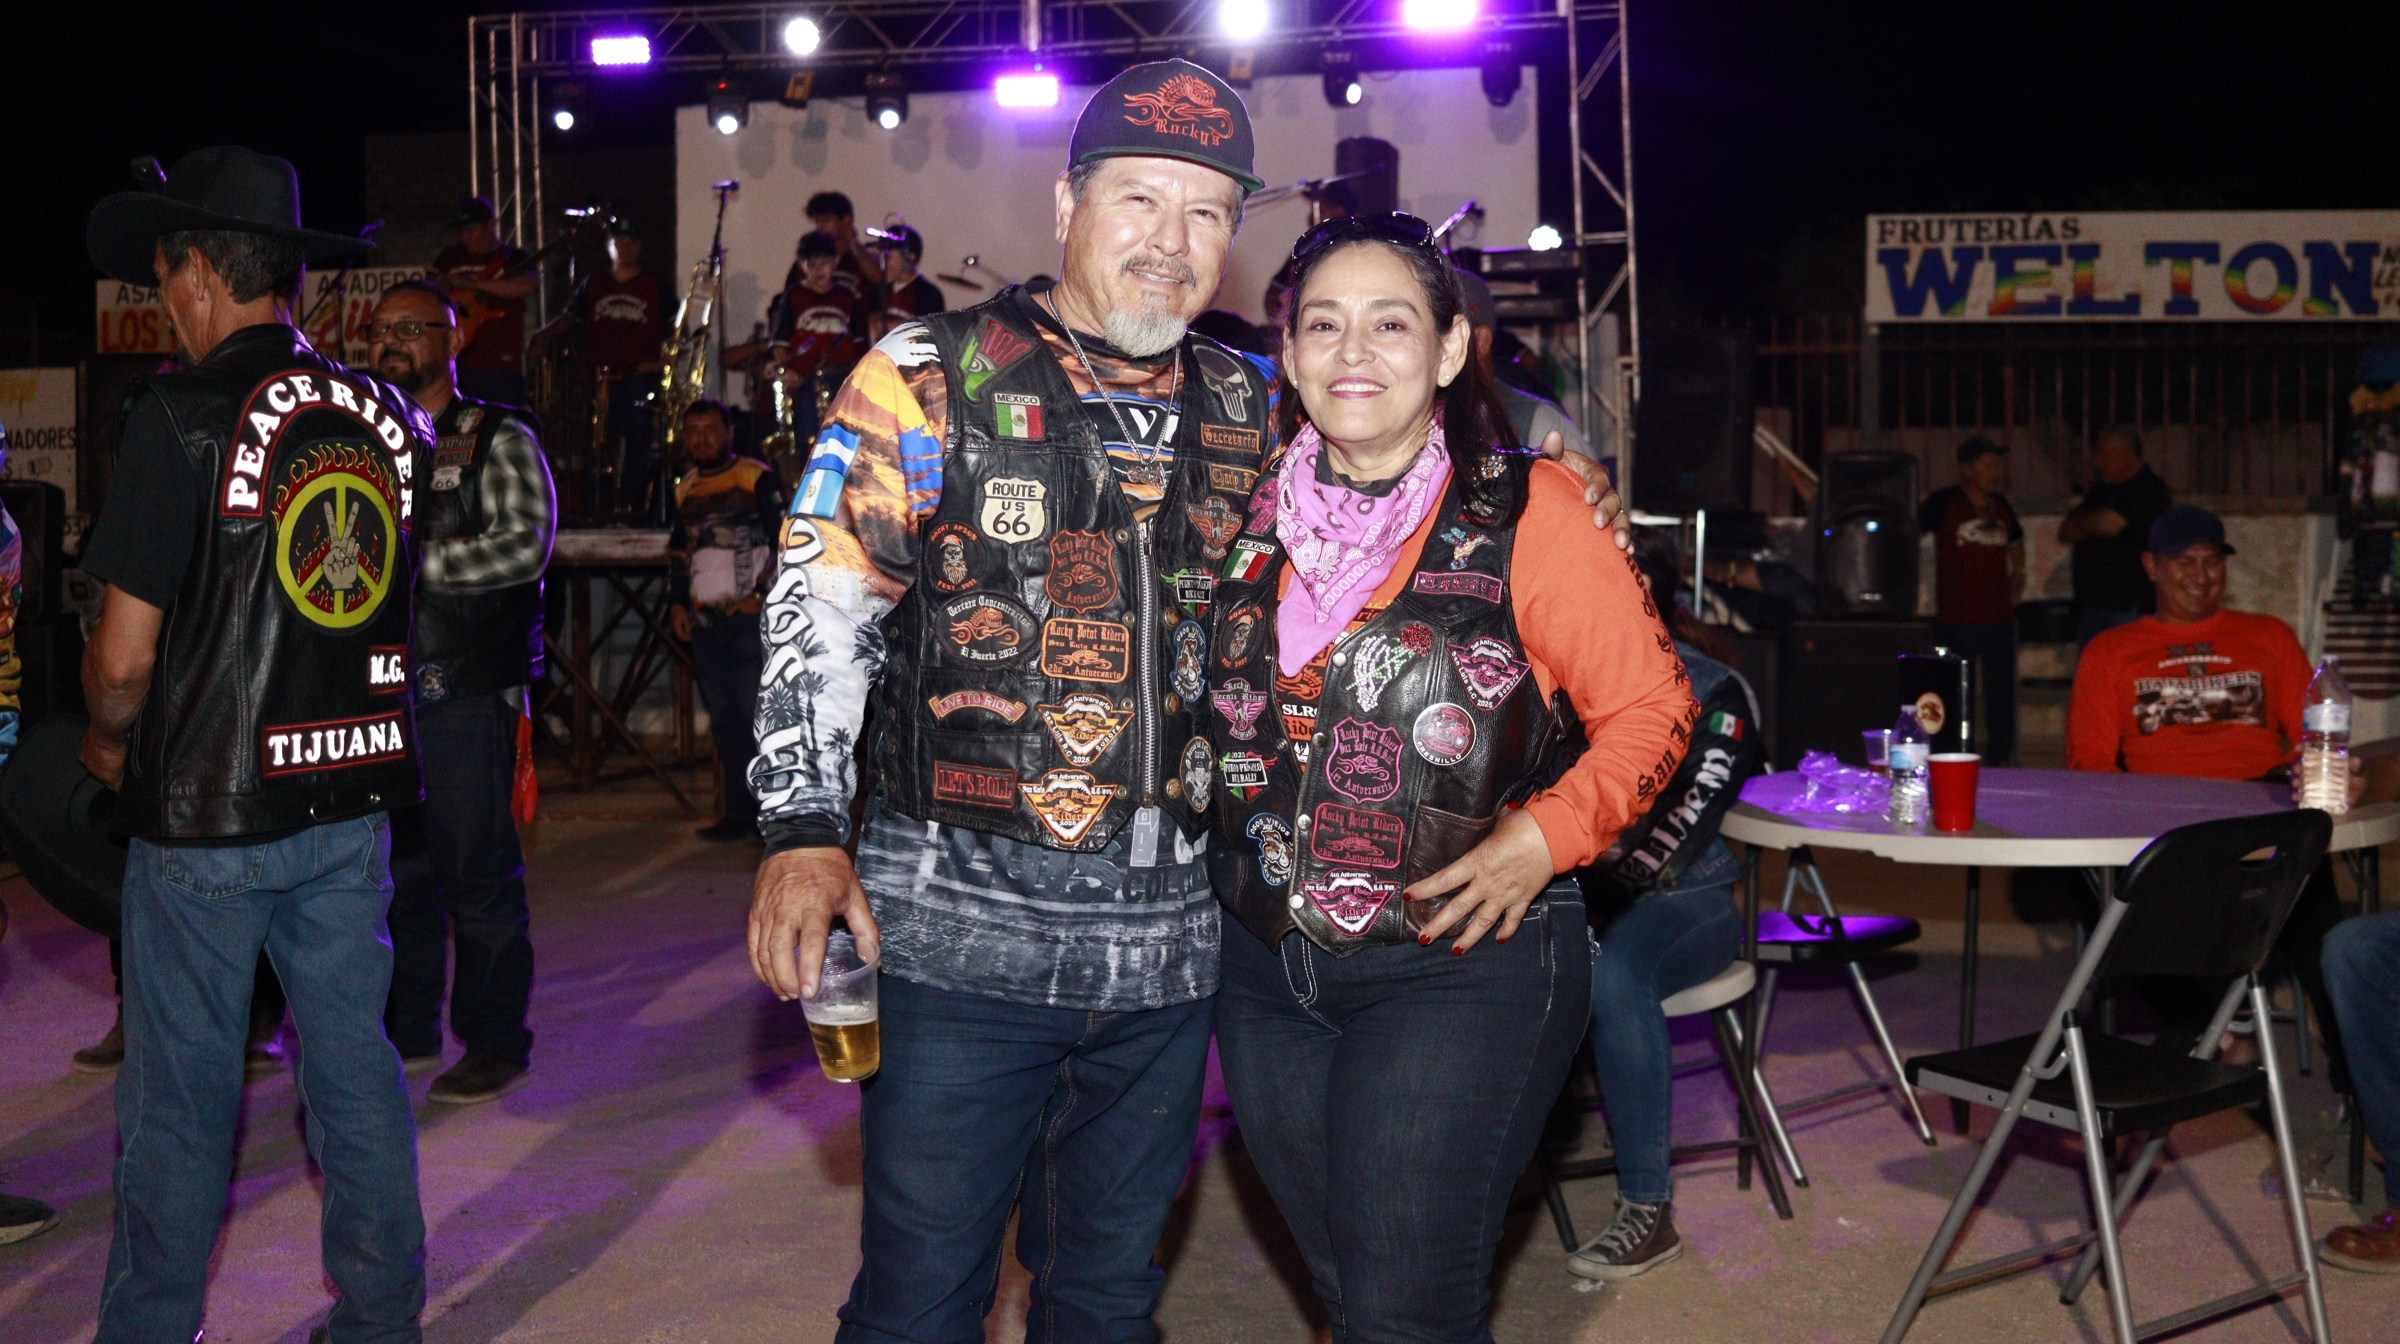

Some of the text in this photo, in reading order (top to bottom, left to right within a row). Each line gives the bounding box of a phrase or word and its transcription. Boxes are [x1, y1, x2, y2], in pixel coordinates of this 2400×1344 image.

[1876, 213, 2081, 245] FRUTERÍAS
[1877, 240, 2380, 317] WELTON
[102, 309, 160, 352] LOS
[996, 394, 1038, 405] MEXICO
[227, 374, 322, 511] PEACE
[992, 482, 1037, 497] ROUTE
[992, 511, 1031, 536] 66
[1240, 540, 1273, 552] MEXICO
[947, 600, 977, 617] Tercera
[1050, 621, 1073, 640] Rocky
[1101, 626, 1126, 642] Riders
[998, 647, 1019, 659] 2022
[940, 693, 1015, 716] LIVE TO RIDE
[1073, 695, 1111, 711] Aniversario
[268, 720, 404, 766] TIJUANA
[1095, 725, 1121, 752] Sonora
[1417, 741, 1461, 764] FRESNILLO
[939, 769, 1012, 800] LET'S ROLL
[1637, 747, 1677, 802] San
[1266, 817, 1291, 837] VIEJOS
